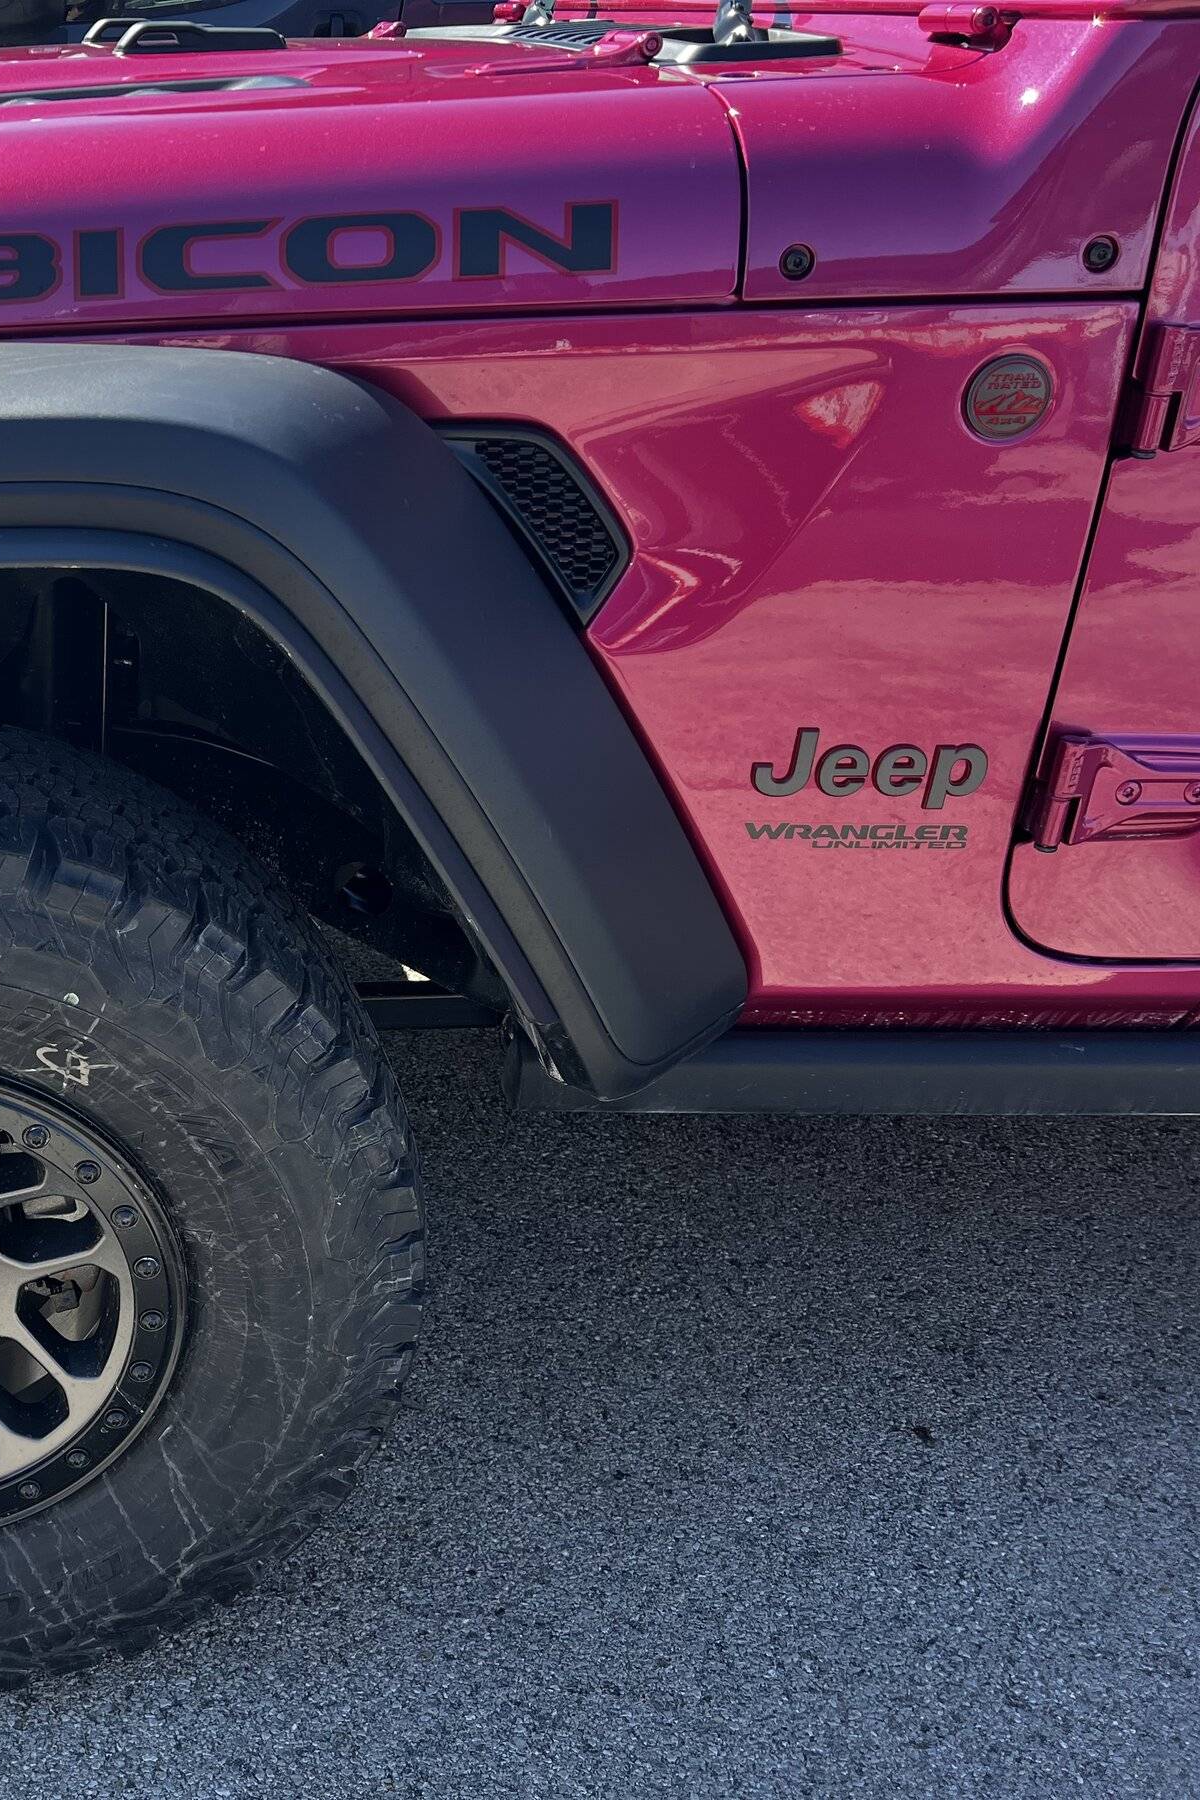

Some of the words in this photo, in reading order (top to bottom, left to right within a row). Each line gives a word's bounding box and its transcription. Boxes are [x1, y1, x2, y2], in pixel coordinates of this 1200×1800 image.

[991, 372, 1040, 381] TRAIL
[750, 727, 989, 810] Jeep
[745, 822, 968, 841] WRANGLER
[811, 840, 967, 849] UNLIMITED
